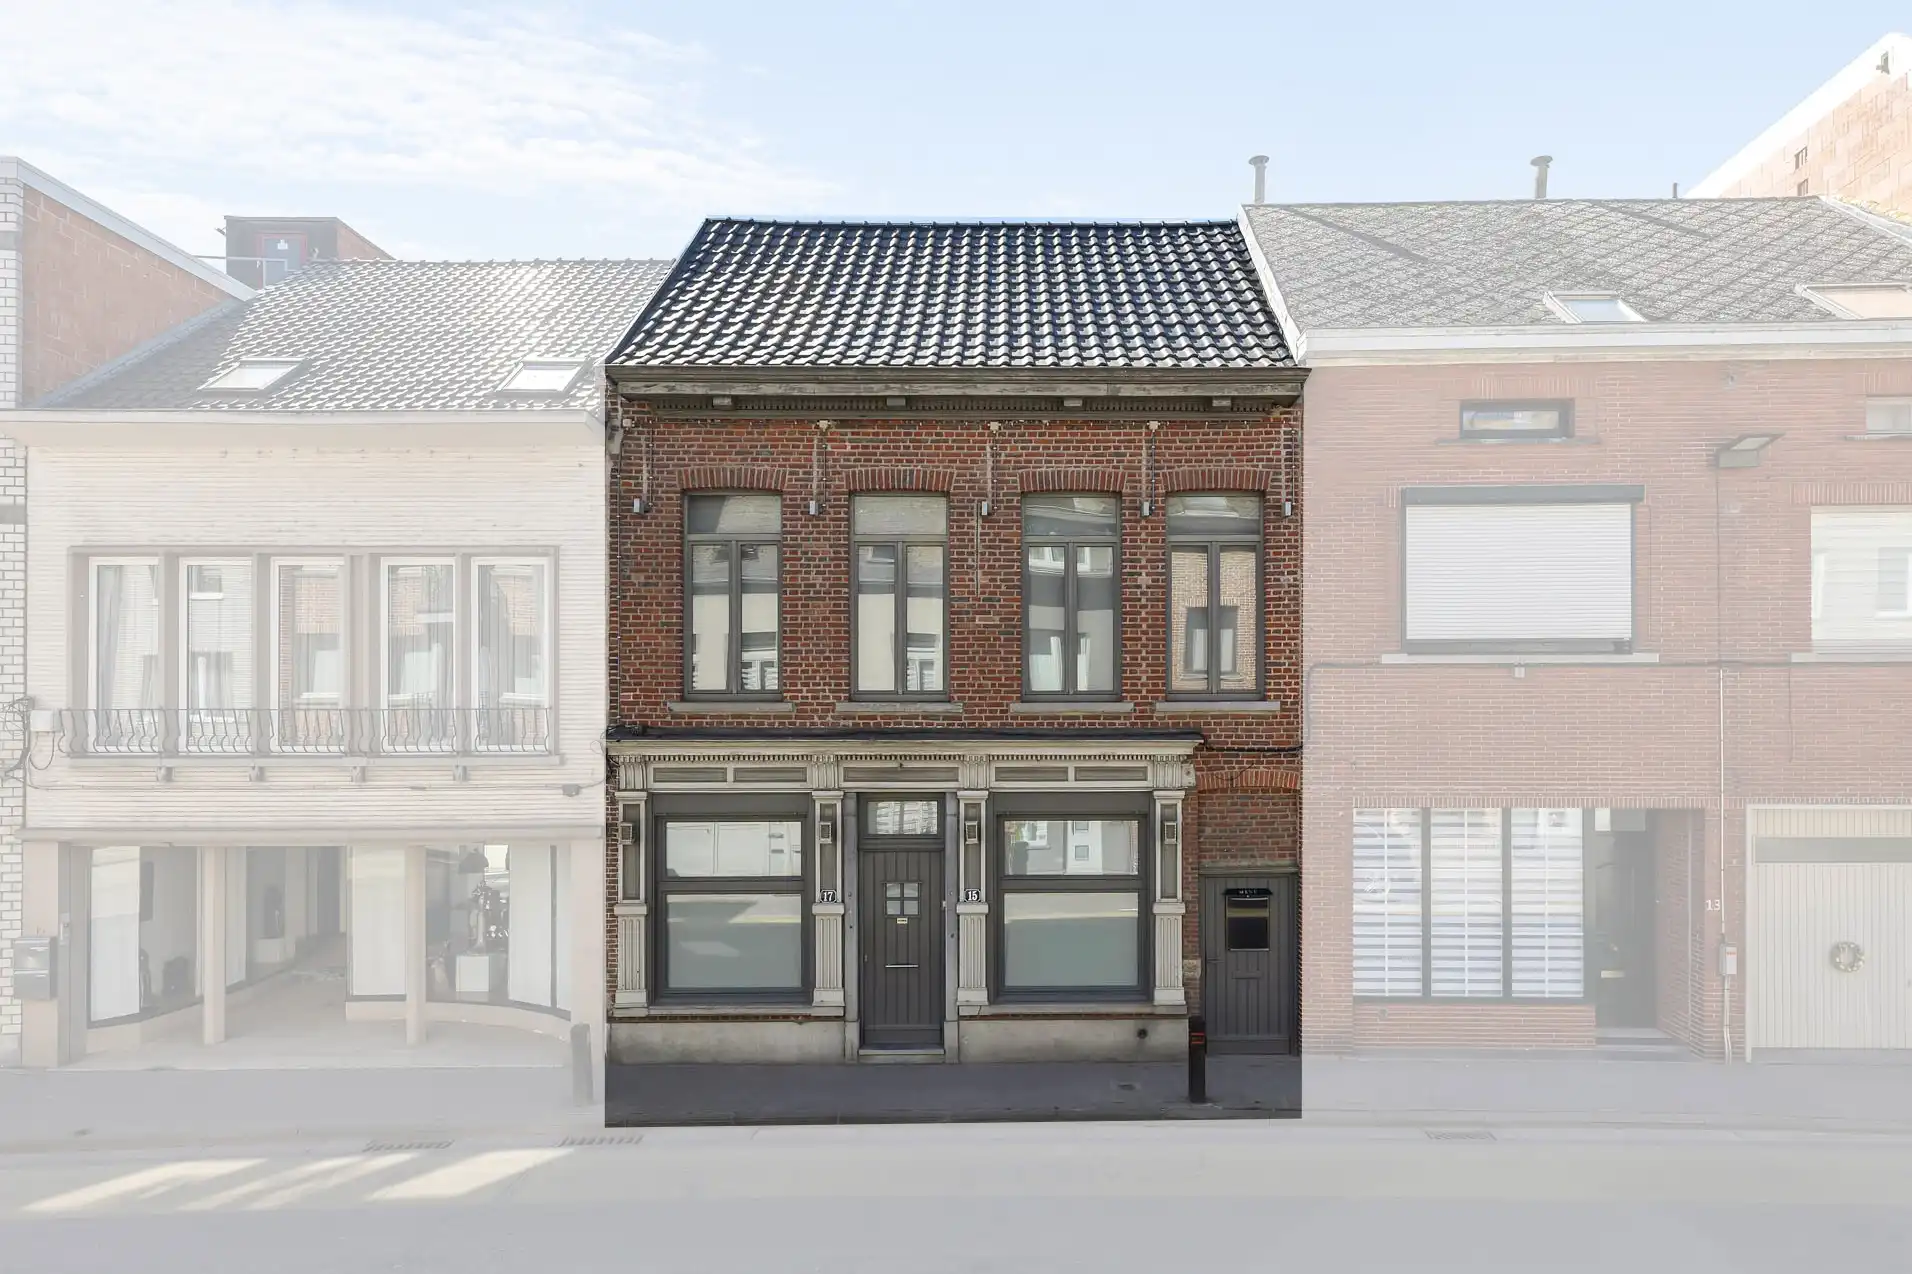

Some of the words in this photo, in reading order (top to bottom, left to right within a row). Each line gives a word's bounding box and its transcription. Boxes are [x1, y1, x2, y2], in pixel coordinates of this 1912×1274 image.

[823, 891, 834, 902] 17
[967, 890, 978, 901] 15
[1705, 899, 1721, 911] 13
